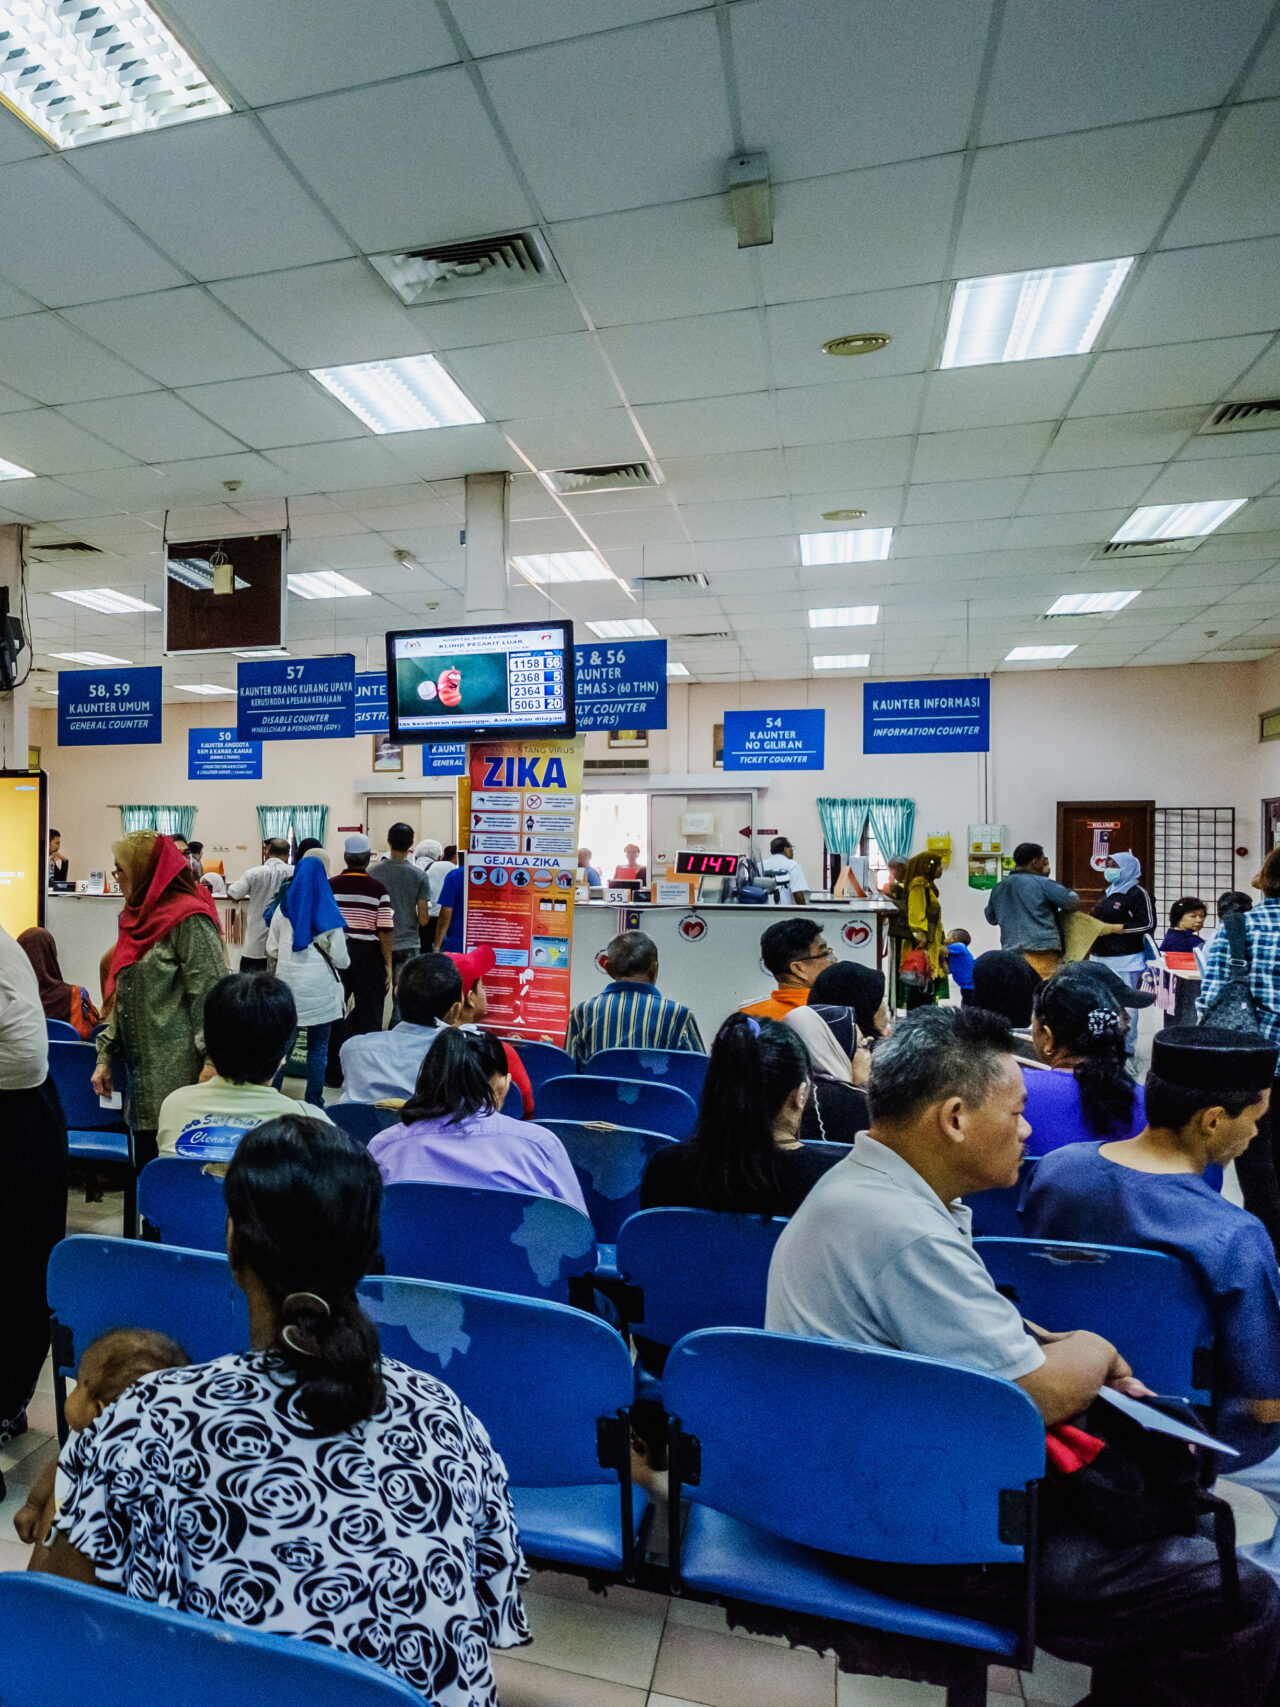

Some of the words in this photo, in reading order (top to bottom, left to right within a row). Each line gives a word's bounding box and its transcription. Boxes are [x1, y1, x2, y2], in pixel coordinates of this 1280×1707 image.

[513, 658, 540, 669] 1158
[546, 657, 561, 668] 56
[575, 652, 584, 666] 5
[590, 651, 602, 665] &
[607, 649, 626, 664] 56
[286, 666, 304, 680] 57
[513, 672, 540, 683] 2368
[554, 670, 561, 680] 5
[576, 667, 622, 680] AUNTER
[89, 684, 110, 699] 58,
[114, 683, 130, 697] 59
[240, 685, 272, 697] KAUNTER
[272, 684, 298, 696] ORANG
[299, 682, 329, 694] KURANG
[330, 682, 352, 693] UPAYA
[355, 684, 386, 697] UNTE
[514, 686, 540, 696] 2364
[554, 685, 561, 696] 5
[577, 682, 608, 695] EMAS
[617, 682, 631, 696] (60
[633, 681, 659, 695] THN)
[250, 698, 270, 707] KERUSI
[270, 698, 285, 706] RODA
[290, 696, 312, 706] PESARA
[312, 695, 342, 704] KERAJAAN
[514, 700, 540, 710] 5063
[546, 698, 562, 709] 20
[873, 698, 920, 710] KAUNTER
[924, 696, 980, 708] INFORMASI
[69, 702, 116, 714] KAUNTER
[118, 701, 150, 712] UMUM
[593, 702, 647, 714] COUNTER
[262, 715, 293, 725] DISABLE
[294, 714, 330, 724] COUNTER
[355, 712, 388, 722] GISTR
[596, 715, 619, 726] YRS)
[766, 718, 782, 728] 54
[70, 720, 106, 730] GENERAL
[108, 720, 149, 729] COUNTER
[251, 725, 286, 734] WHEELCHAIR
[324, 723, 341, 732] (GOV)
[218, 732, 232, 741] 50
[750, 730, 796, 740] KAUNTER
[873, 726, 936, 737] INFORMATION
[936, 726, 980, 735] COUNTER
[432, 744, 466, 754] KAUNTE
[746, 741, 760, 750] NO
[764, 740, 802, 749] GILIRAN
[740, 756, 768, 764] TICKET
[768, 756, 808, 764] COUNTER
[483, 756, 567, 788] ZIKA
[484, 856, 530, 866] GEJALA
[532, 858, 560, 868] ZIKA
[686, 856, 736, 873] 1147
[610, 893, 623, 902] 55
[190, 1131, 226, 1144] Clean
